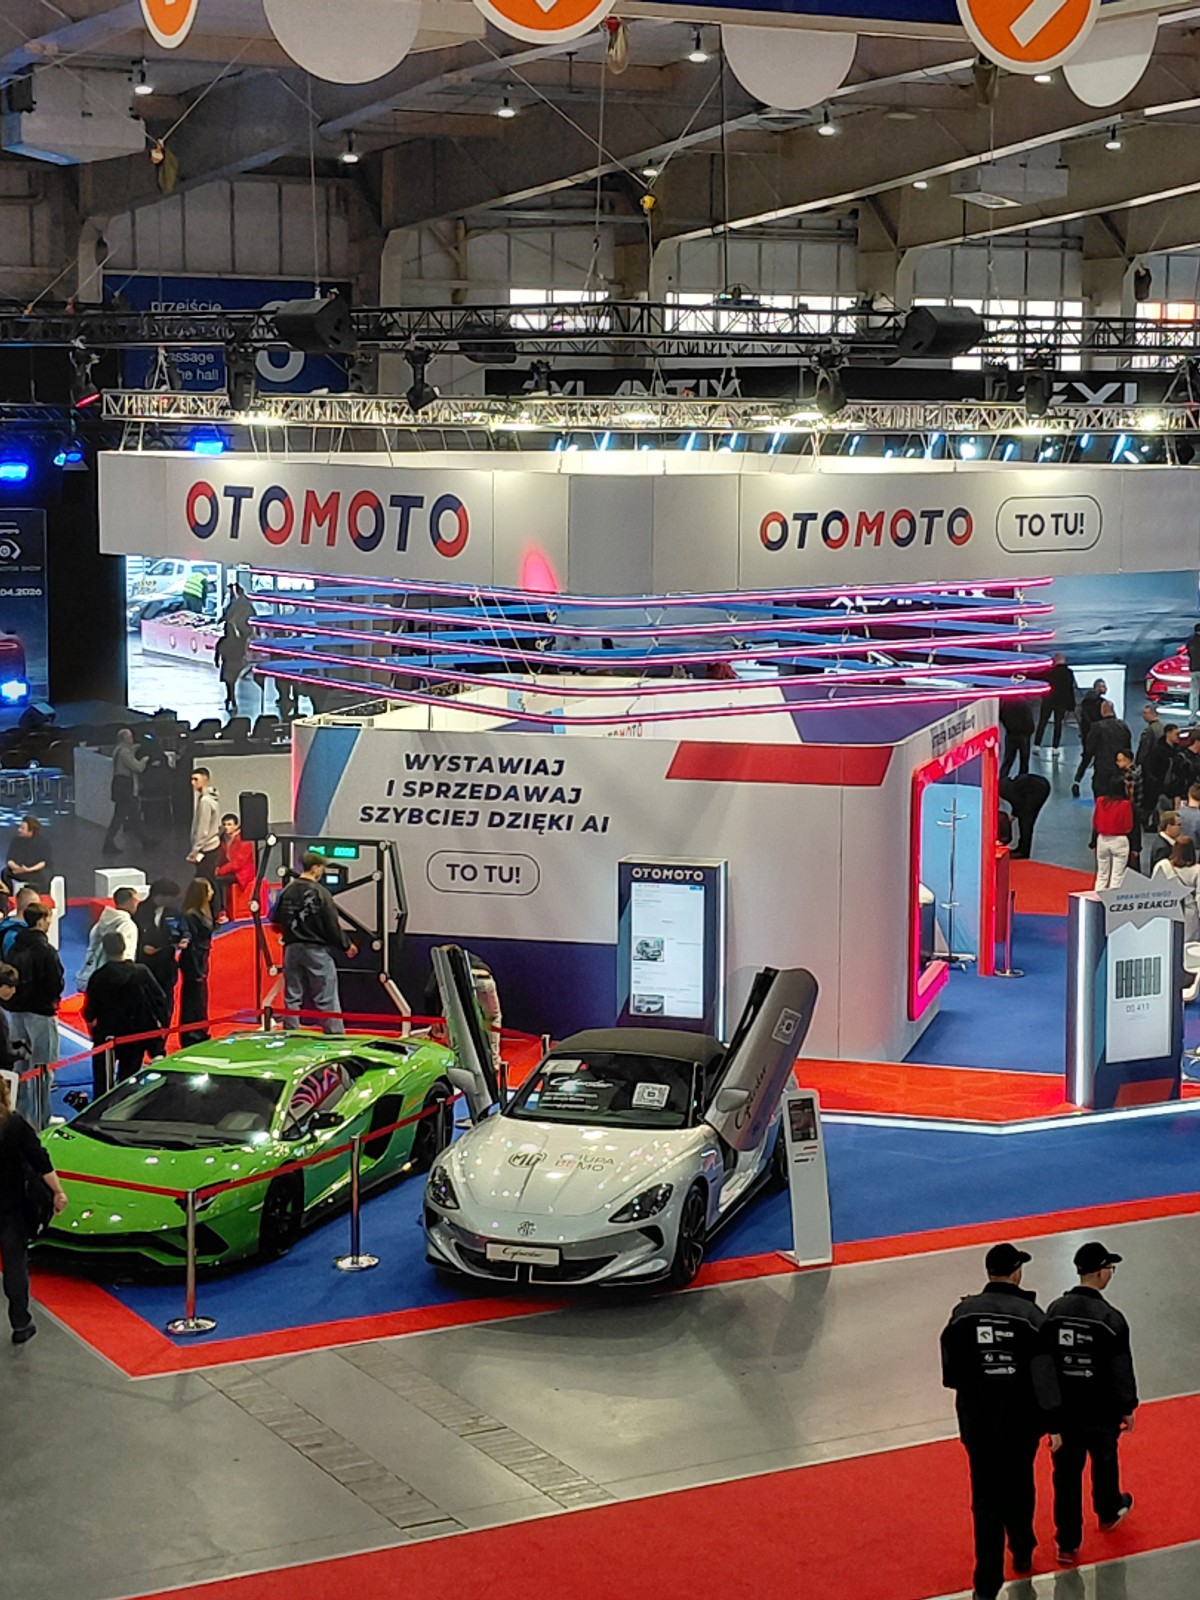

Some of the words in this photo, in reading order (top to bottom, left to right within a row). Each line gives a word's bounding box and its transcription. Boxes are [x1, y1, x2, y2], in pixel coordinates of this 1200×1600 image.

[196, 368, 219, 381] hall
[186, 480, 469, 558] OTOMOTO
[760, 507, 974, 552] OTOMOTO
[1015, 513, 1045, 537] TO
[1051, 513, 1085, 536] TU!
[404, 752, 566, 778] WYSTAWIAJ
[386, 779, 395, 798] I
[402, 780, 583, 805] SPRZEDAWAJ
[359, 805, 479, 828] SZYBCIEJ
[487, 812, 574, 836] DZIĘKI
[582, 814, 611, 833] AI
[446, 863, 478, 883] TO
[488, 864, 521, 884] TU!
[631, 867, 704, 882] OTOMOTO
[1109, 902, 1135, 913] CZAS
[1137, 899, 1178, 910] REAKCJI
